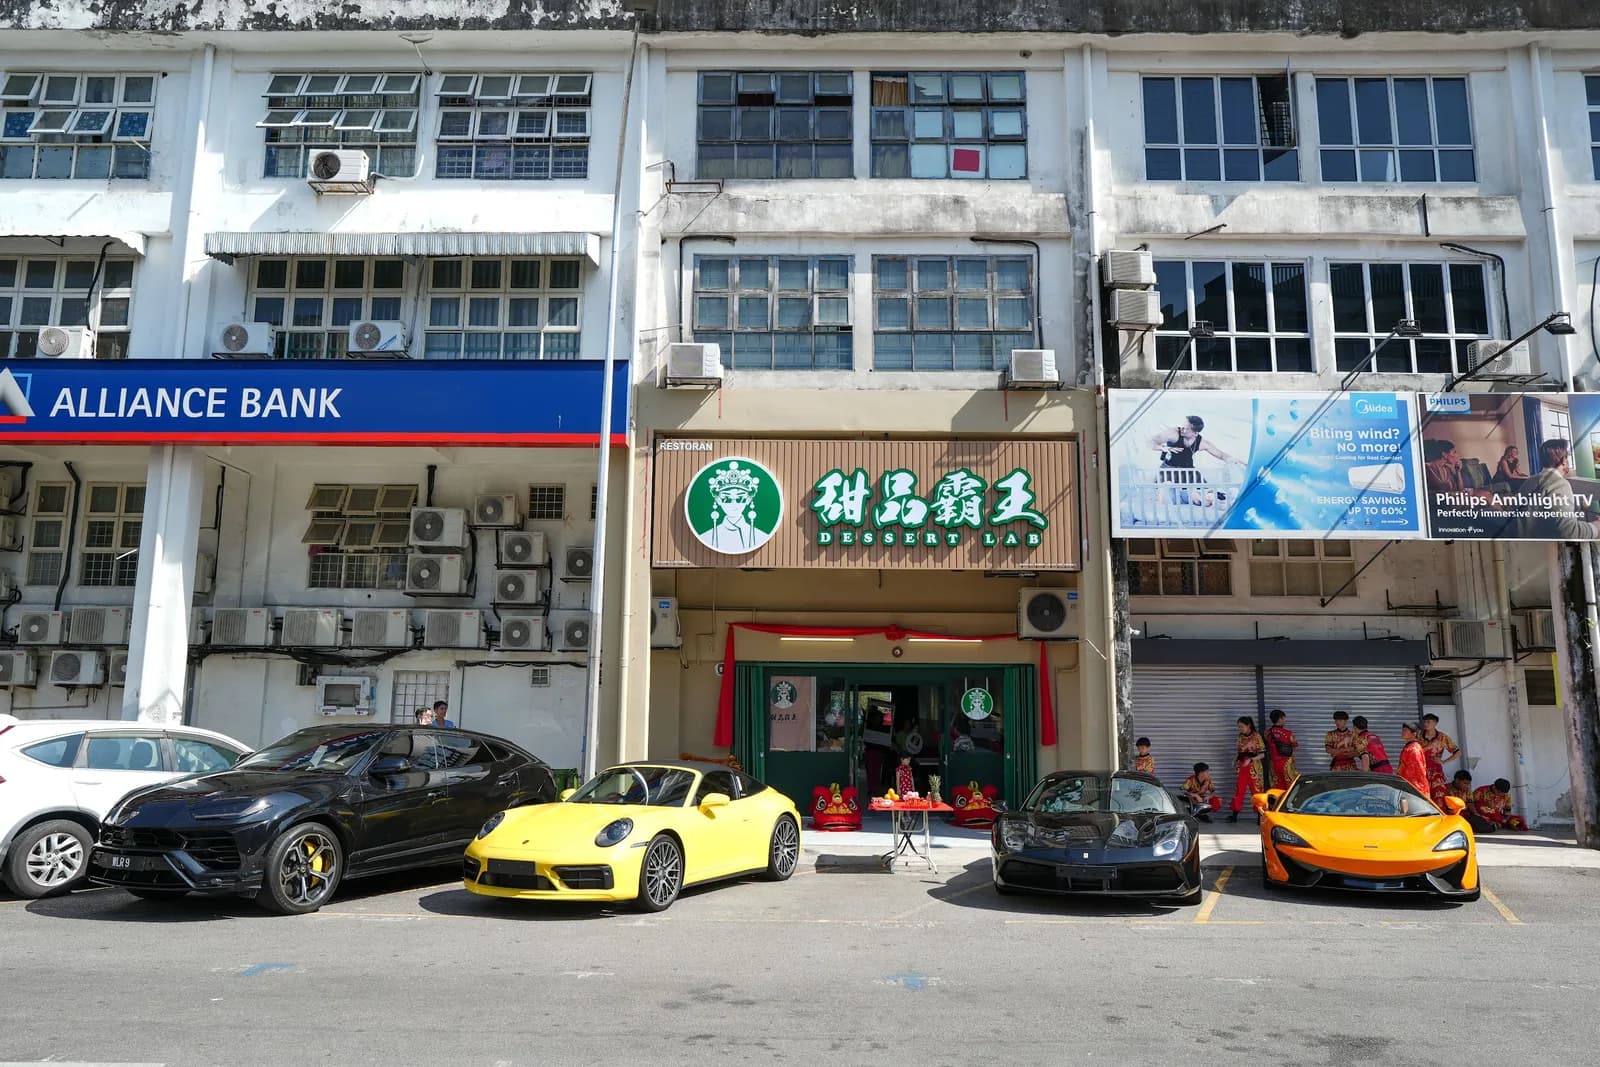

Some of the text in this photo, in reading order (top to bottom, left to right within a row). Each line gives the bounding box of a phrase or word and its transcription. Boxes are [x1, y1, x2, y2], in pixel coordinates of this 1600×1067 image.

[49, 387, 343, 418] ALLIANCE BANK
[1357, 401, 1393, 413] Midea
[1430, 397, 1466, 406] PHILIPS
[1310, 428, 1400, 441] Biting wind?
[660, 442, 713, 451] RESTORAN
[1337, 443, 1402, 453] NO more!
[813, 470, 1046, 528] 甜品霸王
[1317, 496, 1407, 505] ENERGY SAVINGS
[1436, 493, 1593, 509] Philips Ambilight TV
[1347, 507, 1361, 515] UP
[1365, 507, 1378, 515] TO
[1437, 509, 1585, 520] Perfectly immersive experience
[1438, 526, 1466, 534] innovation
[819, 531, 1041, 546] DESSERT LAB
